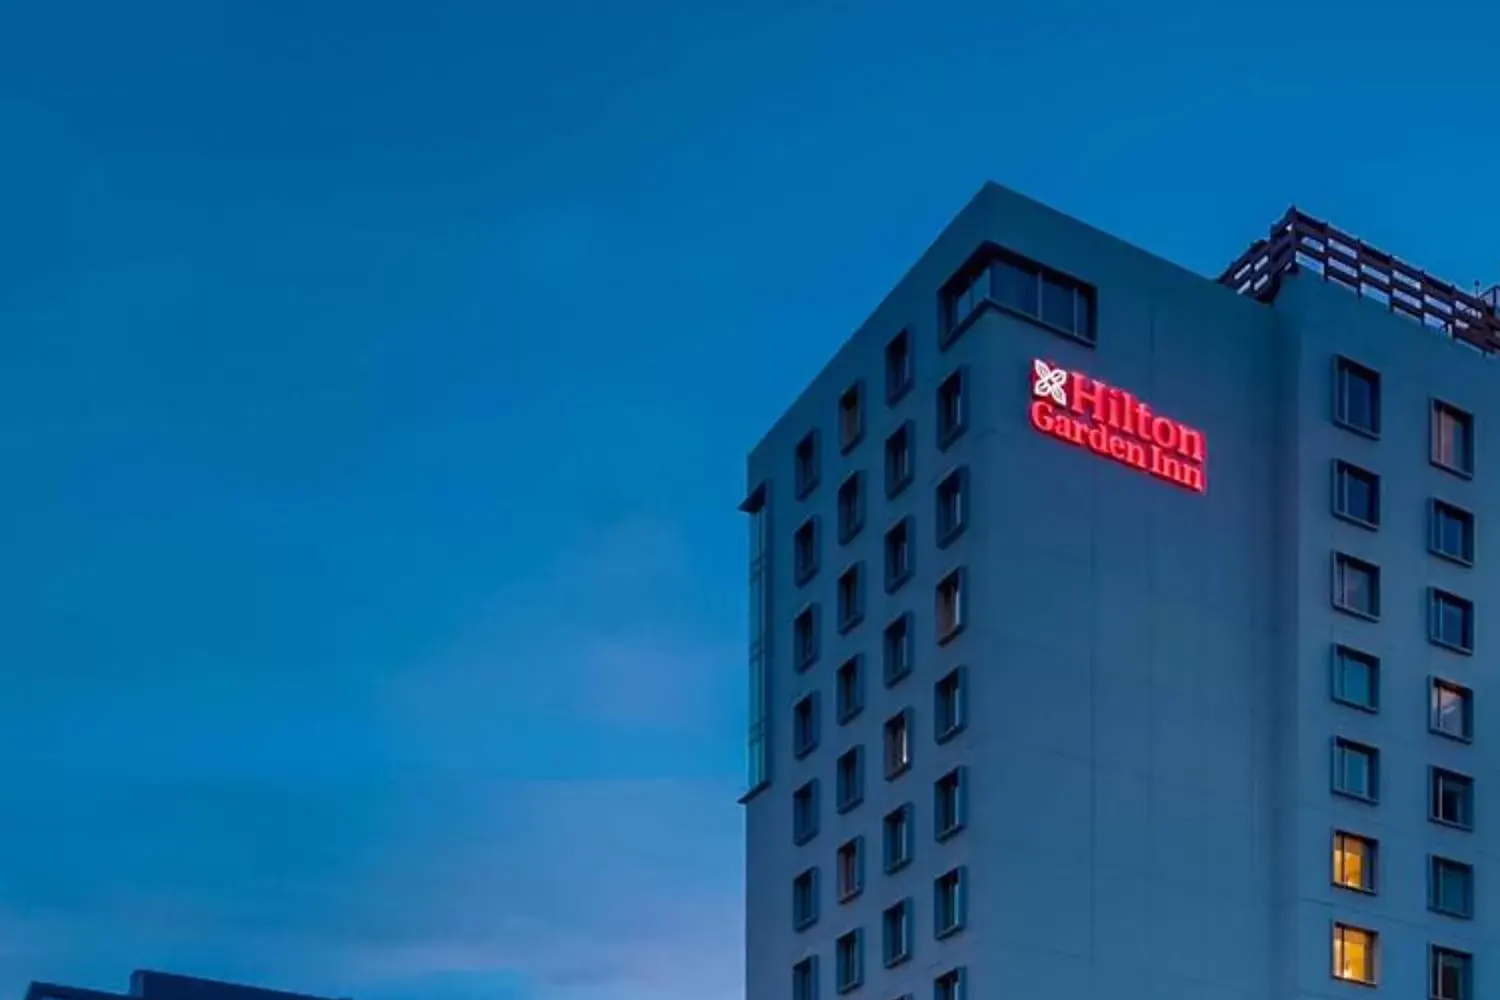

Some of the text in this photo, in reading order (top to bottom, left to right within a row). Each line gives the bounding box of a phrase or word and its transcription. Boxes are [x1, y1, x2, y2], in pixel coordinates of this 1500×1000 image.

[1031, 401, 1205, 492] Garden Inn
[1070, 371, 1205, 462] Hilton
